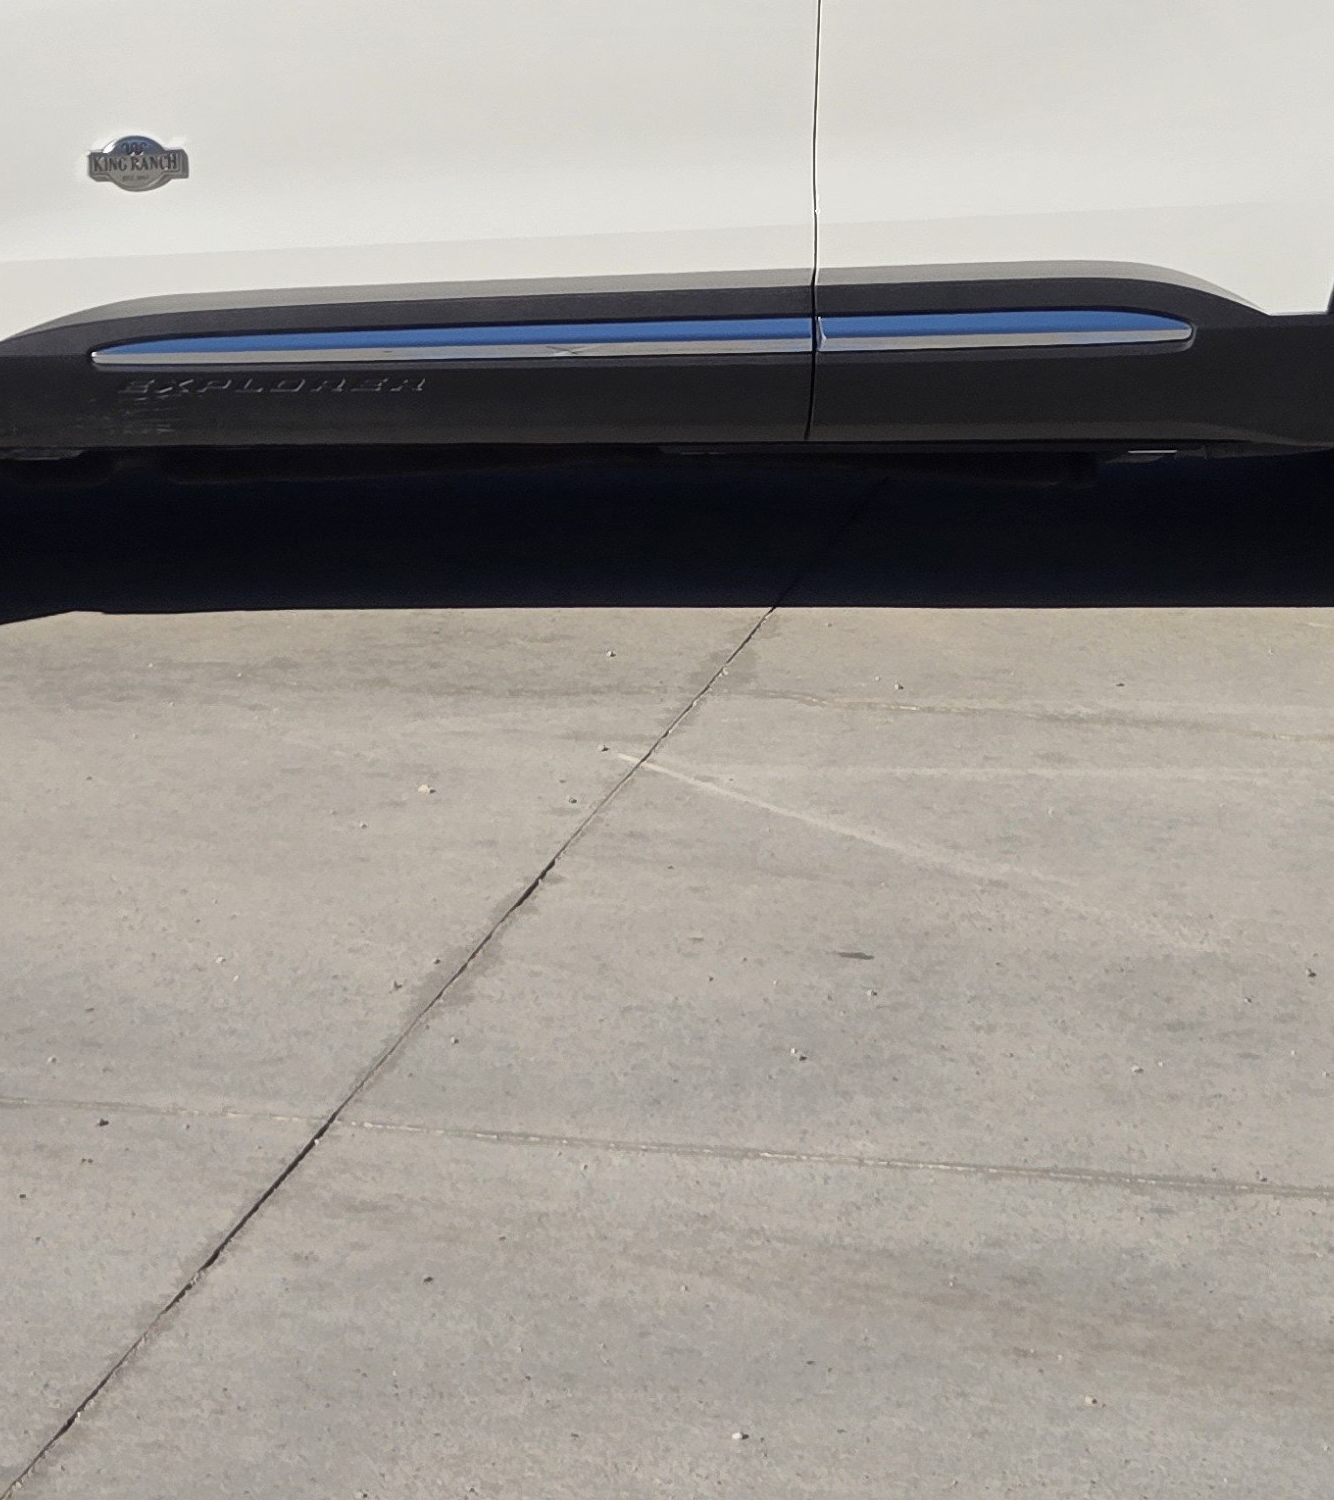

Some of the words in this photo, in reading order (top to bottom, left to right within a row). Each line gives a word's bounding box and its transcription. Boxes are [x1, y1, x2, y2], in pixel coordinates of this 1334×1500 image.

[94, 156, 128, 172] KING
[131, 151, 178, 171] RANCH
[117, 377, 426, 394] EXPLORER
